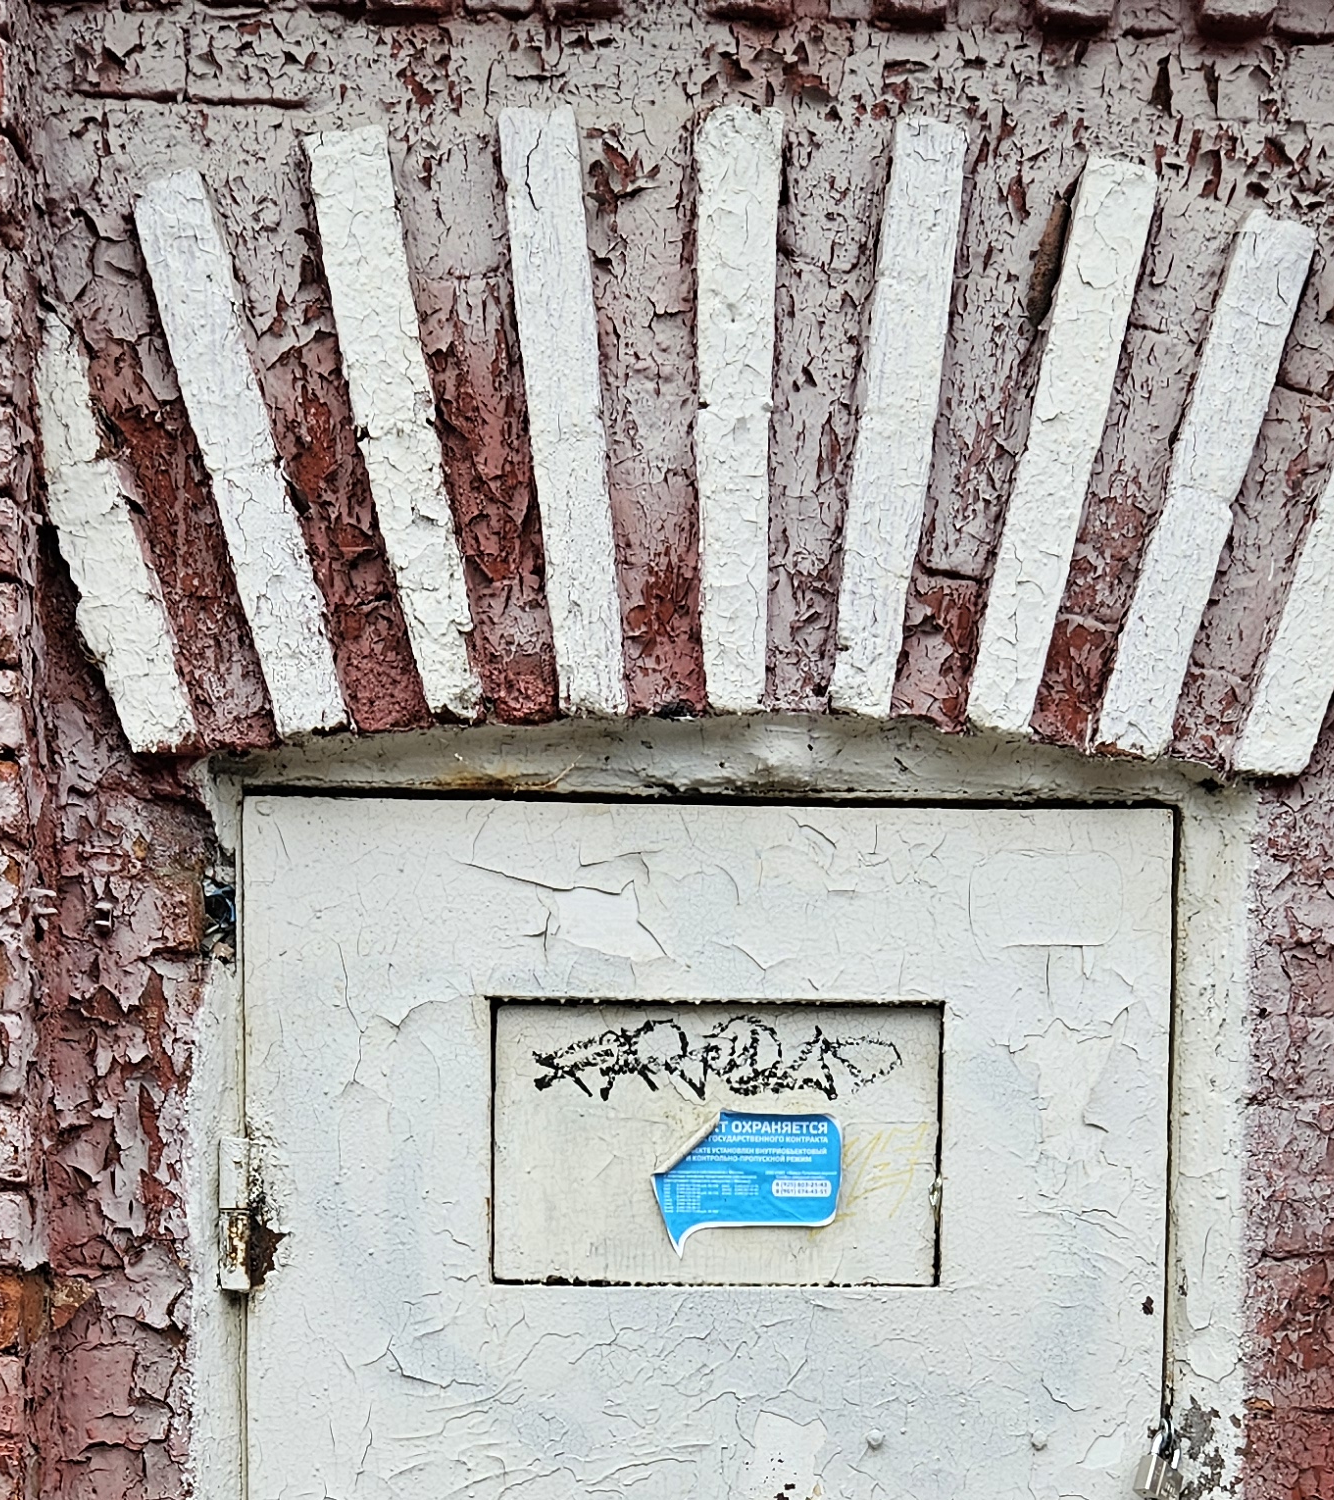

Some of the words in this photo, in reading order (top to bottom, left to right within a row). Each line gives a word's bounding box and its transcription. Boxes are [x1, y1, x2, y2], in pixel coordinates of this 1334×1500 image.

[731, 1120, 828, 1135] ОХРАНЯЕТСЯ
[708, 1135, 784, 1143] ГОСУДАРСТВЕННОГО
[785, 1135, 828, 1144] КОНТРАКТА
[712, 1147, 754, 1155] УСТАНОВЛЕН
